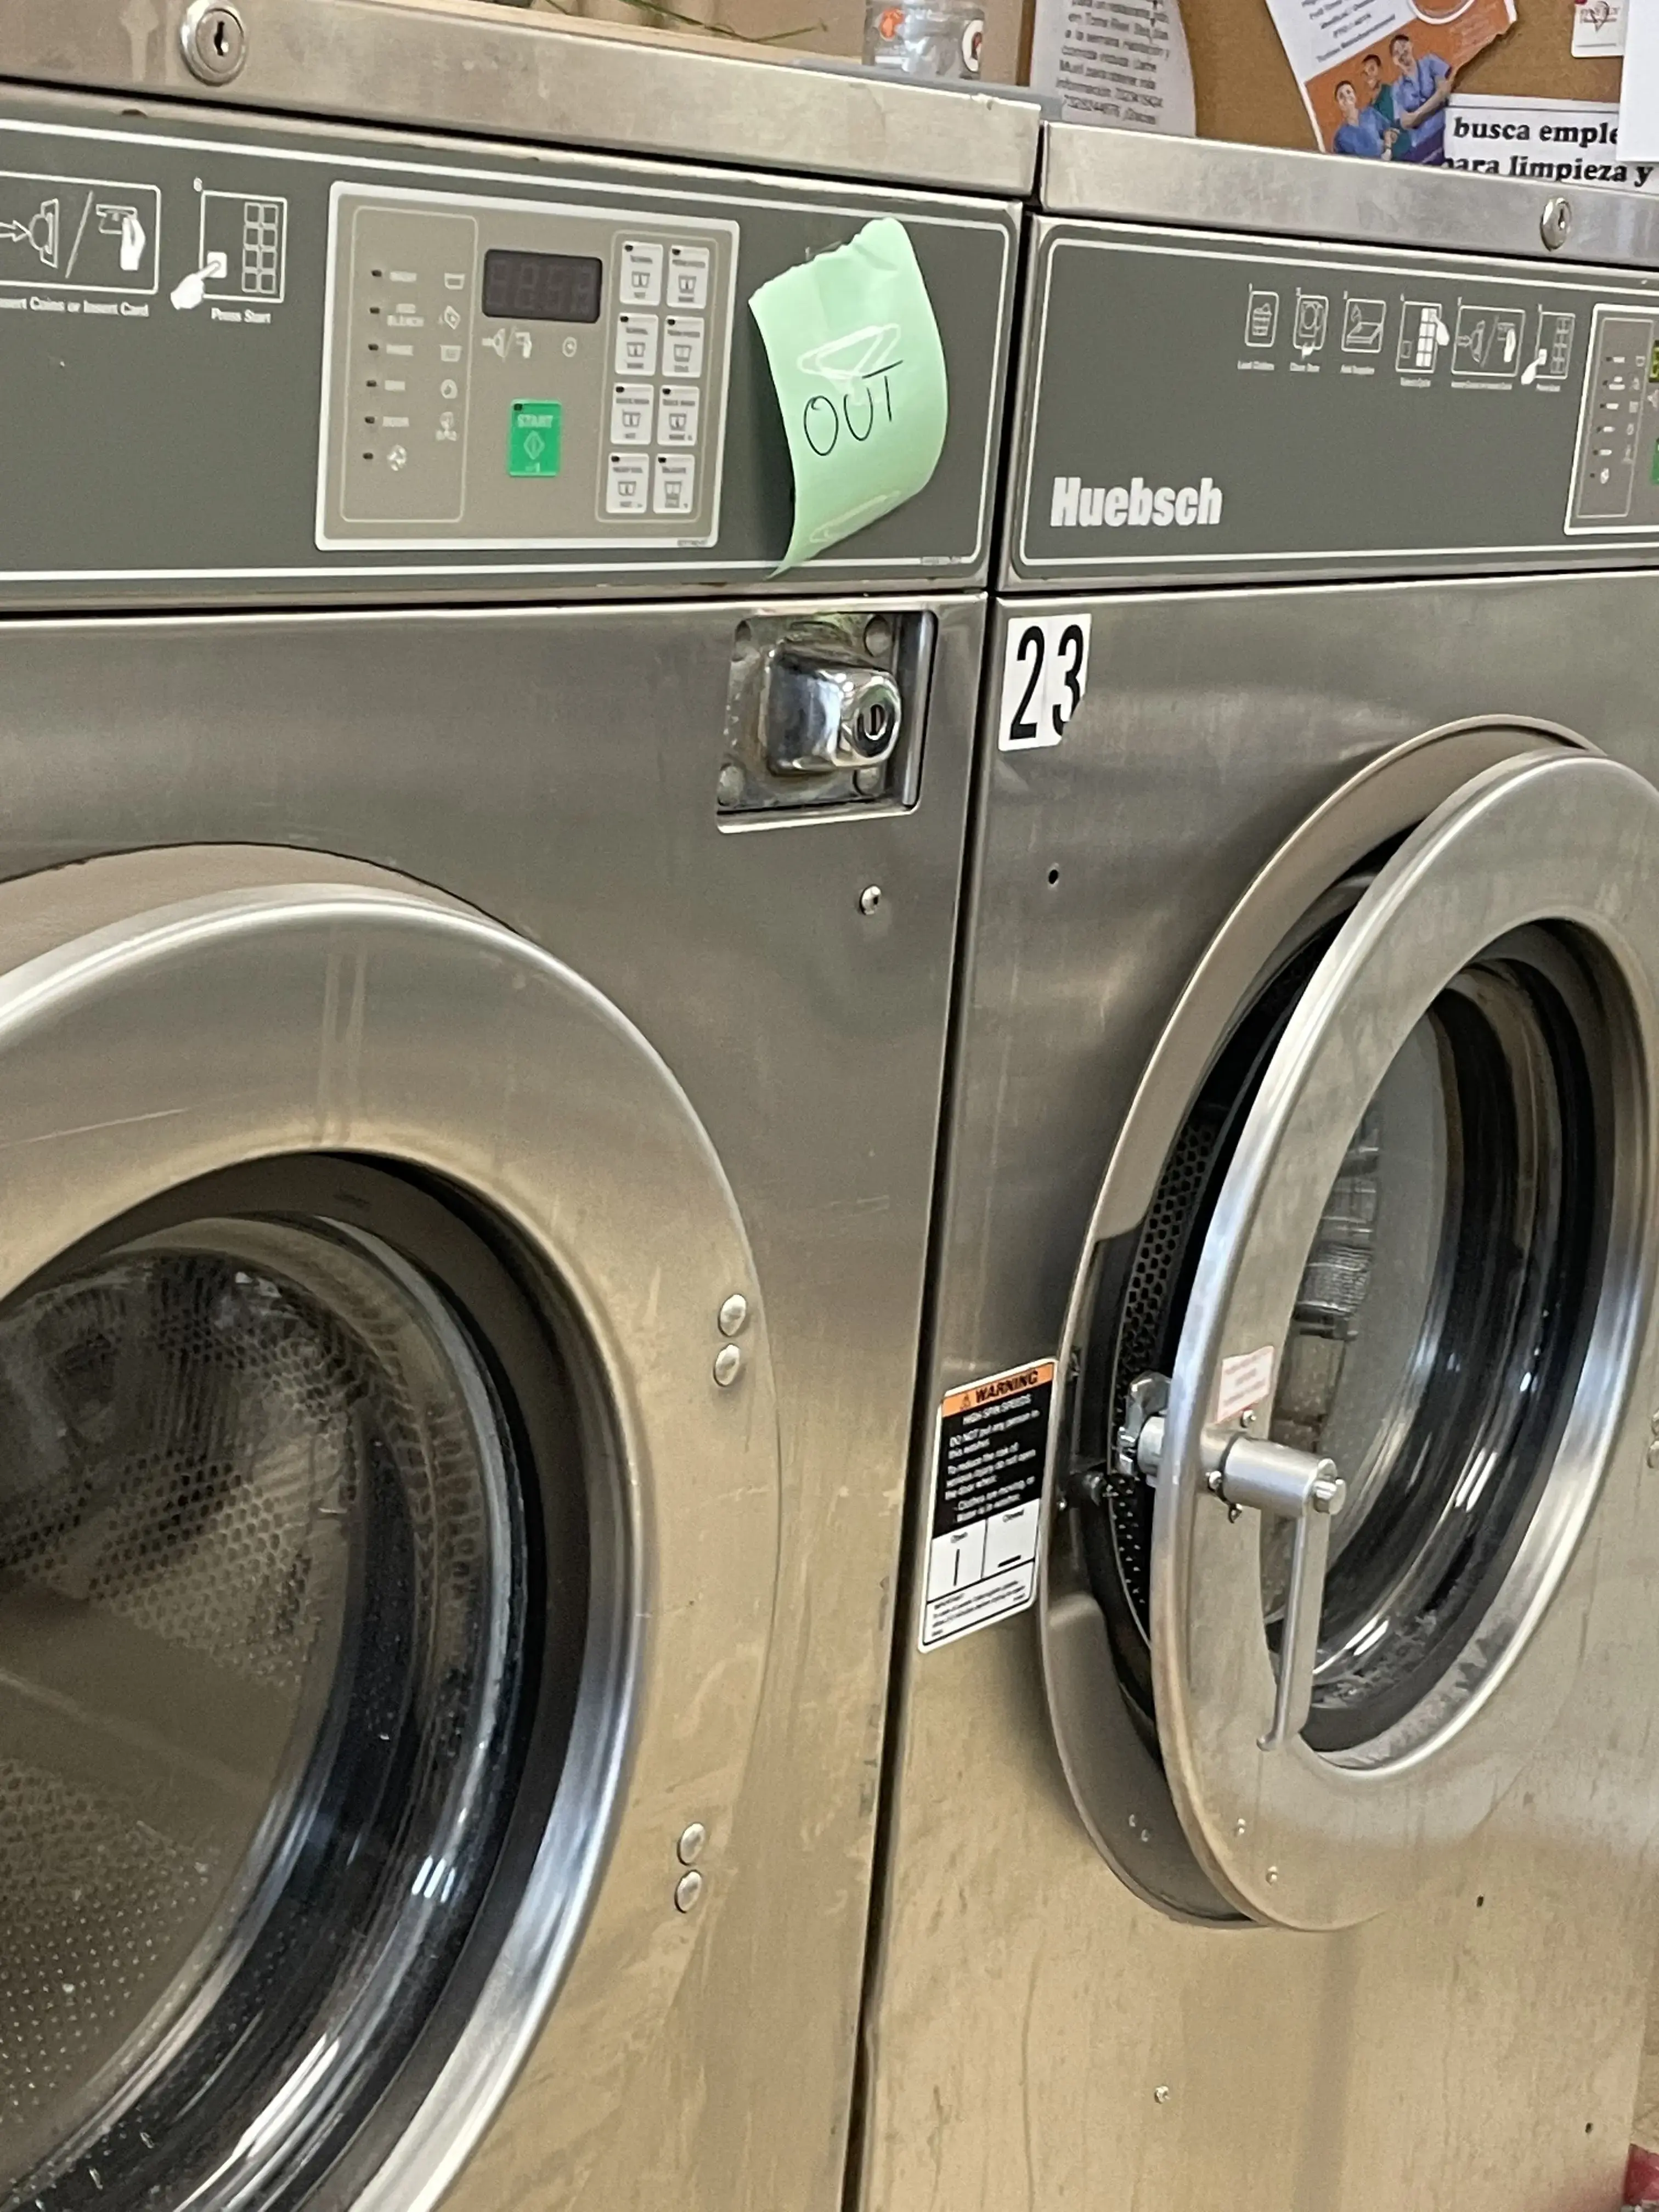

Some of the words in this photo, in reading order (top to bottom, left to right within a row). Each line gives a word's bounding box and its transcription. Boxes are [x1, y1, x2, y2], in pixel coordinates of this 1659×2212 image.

[1453, 116, 1531, 140] busca
[1509, 155, 1628, 182] limpieza
[1634, 165, 1654, 188] y
[517, 413, 554, 428] START
[804, 359, 904, 456] OUT
[1049, 476, 1223, 527] Huebsch
[1009, 624, 1084, 741] 23
[975, 1370, 1039, 1403] WARNING
